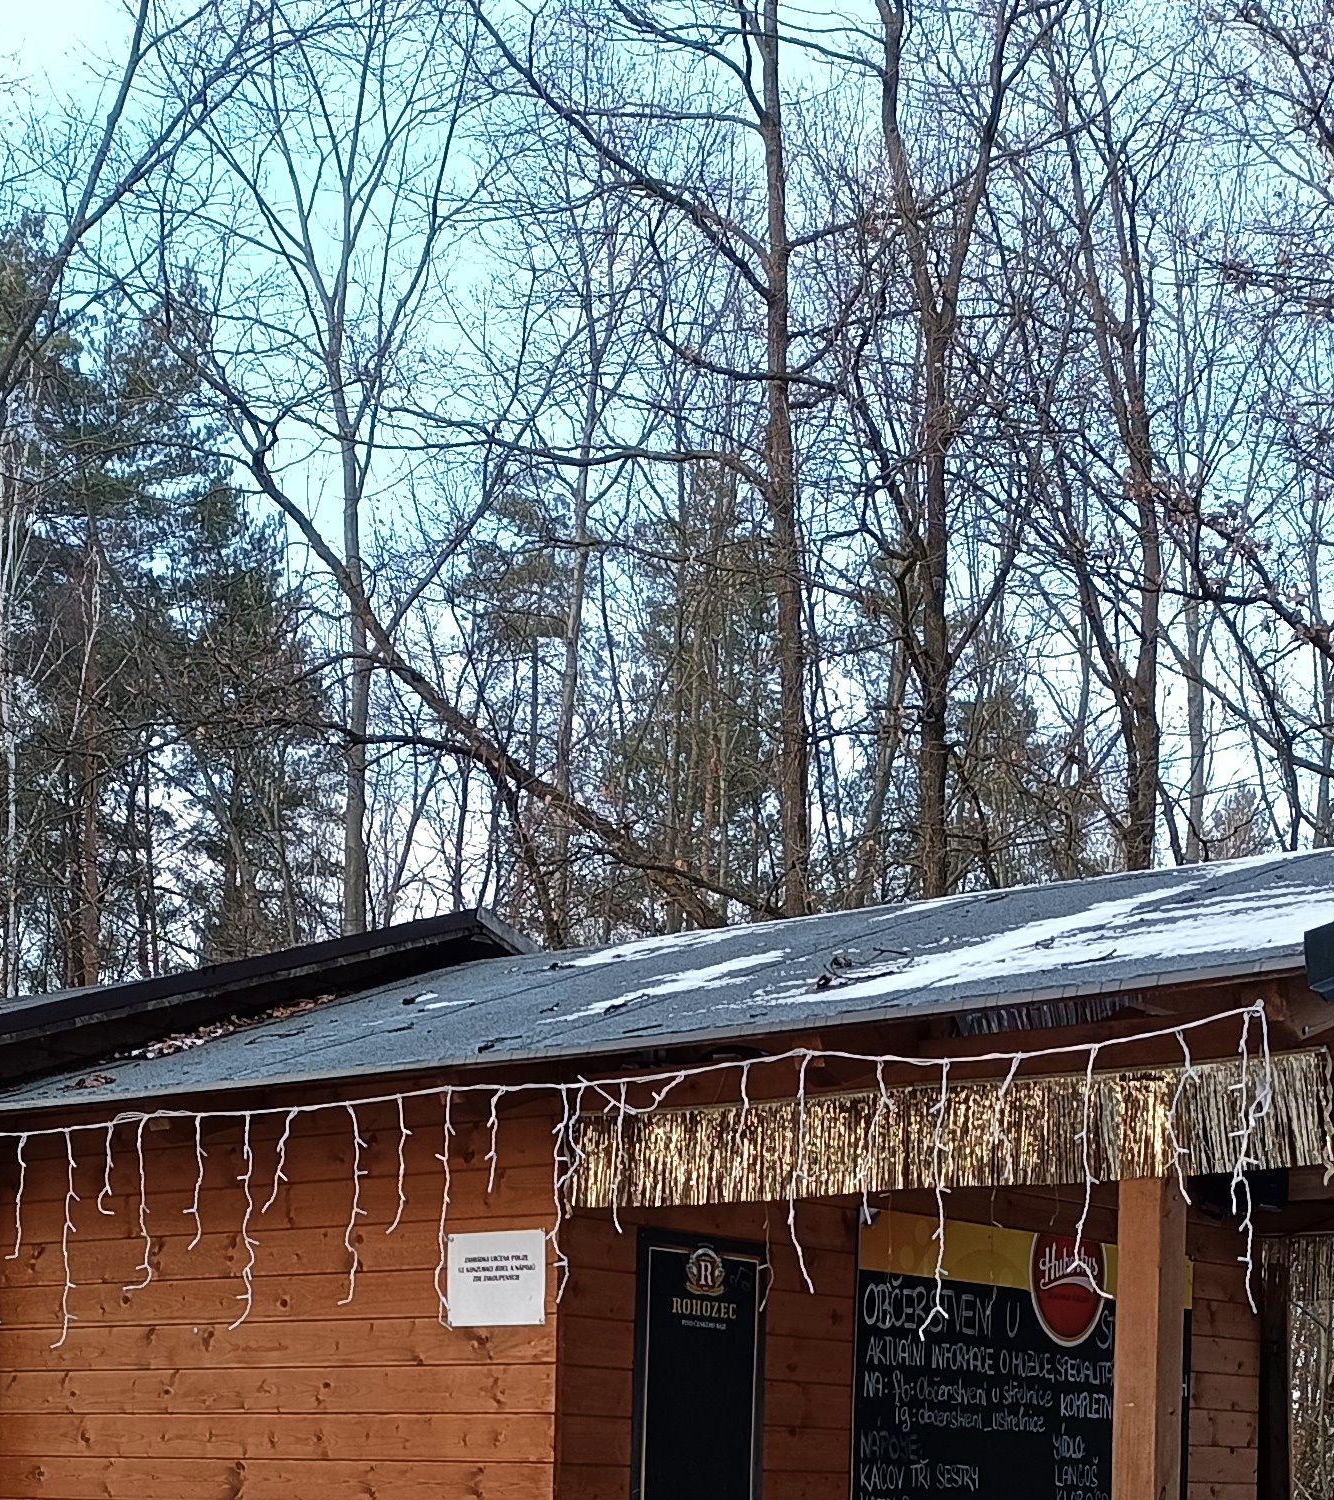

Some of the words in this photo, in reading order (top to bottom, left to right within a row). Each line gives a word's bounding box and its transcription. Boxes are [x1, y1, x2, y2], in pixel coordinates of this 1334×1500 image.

[699, 1261, 713, 1286] R
[671, 1297, 737, 1319] ROHOZEC
[863, 1276, 997, 1339] OBČERSTVENÍ
[1007, 1301, 1020, 1338] U
[932, 1342, 995, 1375] INFORMACE
[1000, 1350, 1009, 1374] O
[864, 1370, 888, 1398] NA:
[893, 1370, 914, 1407] fb:
[992, 1387, 1000, 1403] u
[1060, 1391, 1113, 1420] KOMPLETN
[910, 1458, 930, 1489] TŘI
[937, 1464, 979, 1493] SESTRY
[1054, 1456, 1099, 1487] LANGOŠ
